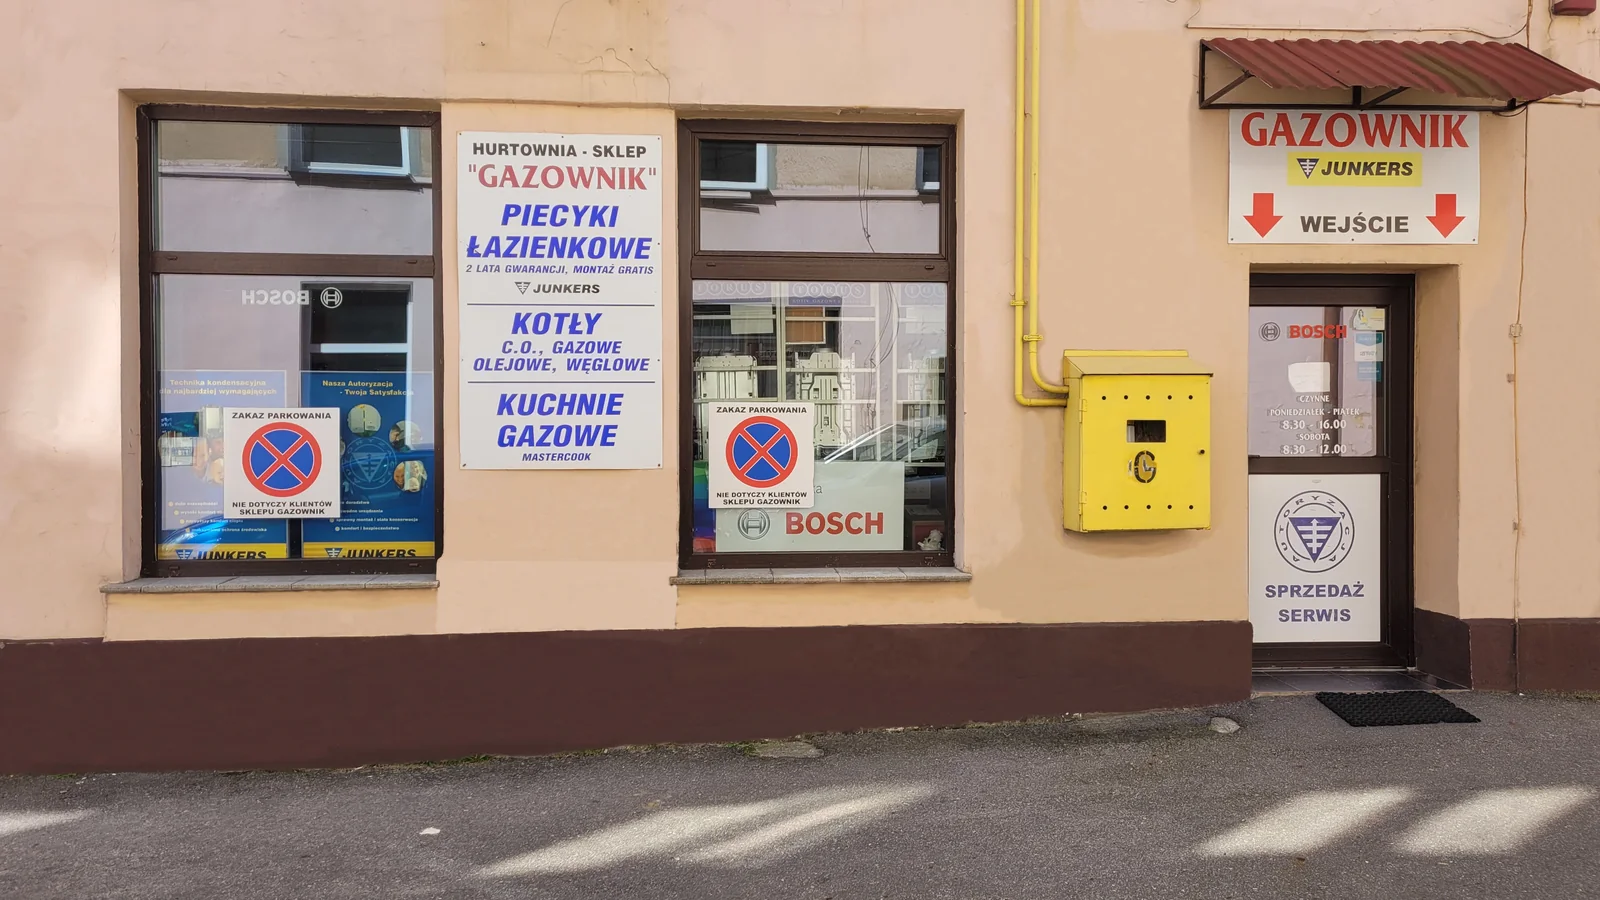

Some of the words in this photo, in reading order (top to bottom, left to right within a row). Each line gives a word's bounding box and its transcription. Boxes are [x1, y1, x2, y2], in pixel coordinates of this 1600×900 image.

[1241, 112, 1470, 149] GAZOWNIK
[472, 142, 577, 157] HURTOWNIA
[592, 145, 647, 158] SKLEP
[1321, 161, 1413, 176] JUNKERS
[468, 164, 656, 190] "GAZOWNIK"
[501, 203, 619, 228] PIECYKI
[1300, 212, 1409, 233] WEJŚCIE
[466, 235, 653, 260] ŁAZIENKOWE
[465, 264, 472, 273] 2
[476, 265, 501, 273] LATA
[504, 265, 568, 275] GWARANCJI,
[573, 263, 614, 274] MONTAŻ
[618, 265, 654, 275] GRATIS
[533, 284, 600, 294] JUNKERS
[511, 312, 603, 335] KOTŁY
[1289, 325, 1347, 339] BOSCH
[501, 340, 543, 356] C.O.,
[552, 341, 622, 354] GAZOWE
[473, 357, 557, 373] OLEJOWE,
[566, 358, 650, 374] WĘGLOWE
[207, 379, 266, 387] kondensacyjna
[347, 380, 393, 388] Autoryzacja
[173, 388, 217, 396] najbardziej
[219, 388, 277, 396] wymagających
[1299, 395, 1330, 403] CZYNNE
[496, 393, 624, 416] KUCHNIE
[267, 412, 332, 420] PARKOWANIA
[1270, 408, 1325, 416] PONIEDZIAŁEK
[1283, 420, 1306, 430] 8.30
[1319, 419, 1347, 429] 16.00
[497, 424, 618, 448] GAZOWE
[1299, 433, 1331, 441] SOBOTA
[1283, 444, 1306, 455] 8.30
[522, 453, 592, 461] MASTERCOOK
[1134, 450, 1157, 483] G
[768, 490, 807, 498] KLIENTÓW
[289, 500, 333, 508] KLIENTÓW
[786, 512, 883, 535] BOSCH
[192, 551, 267, 560] JUNKERS
[343, 549, 416, 558] JUNKERS
[1265, 581, 1365, 598] SPRZEDAŻ
[1278, 609, 1351, 623] SERWIS
